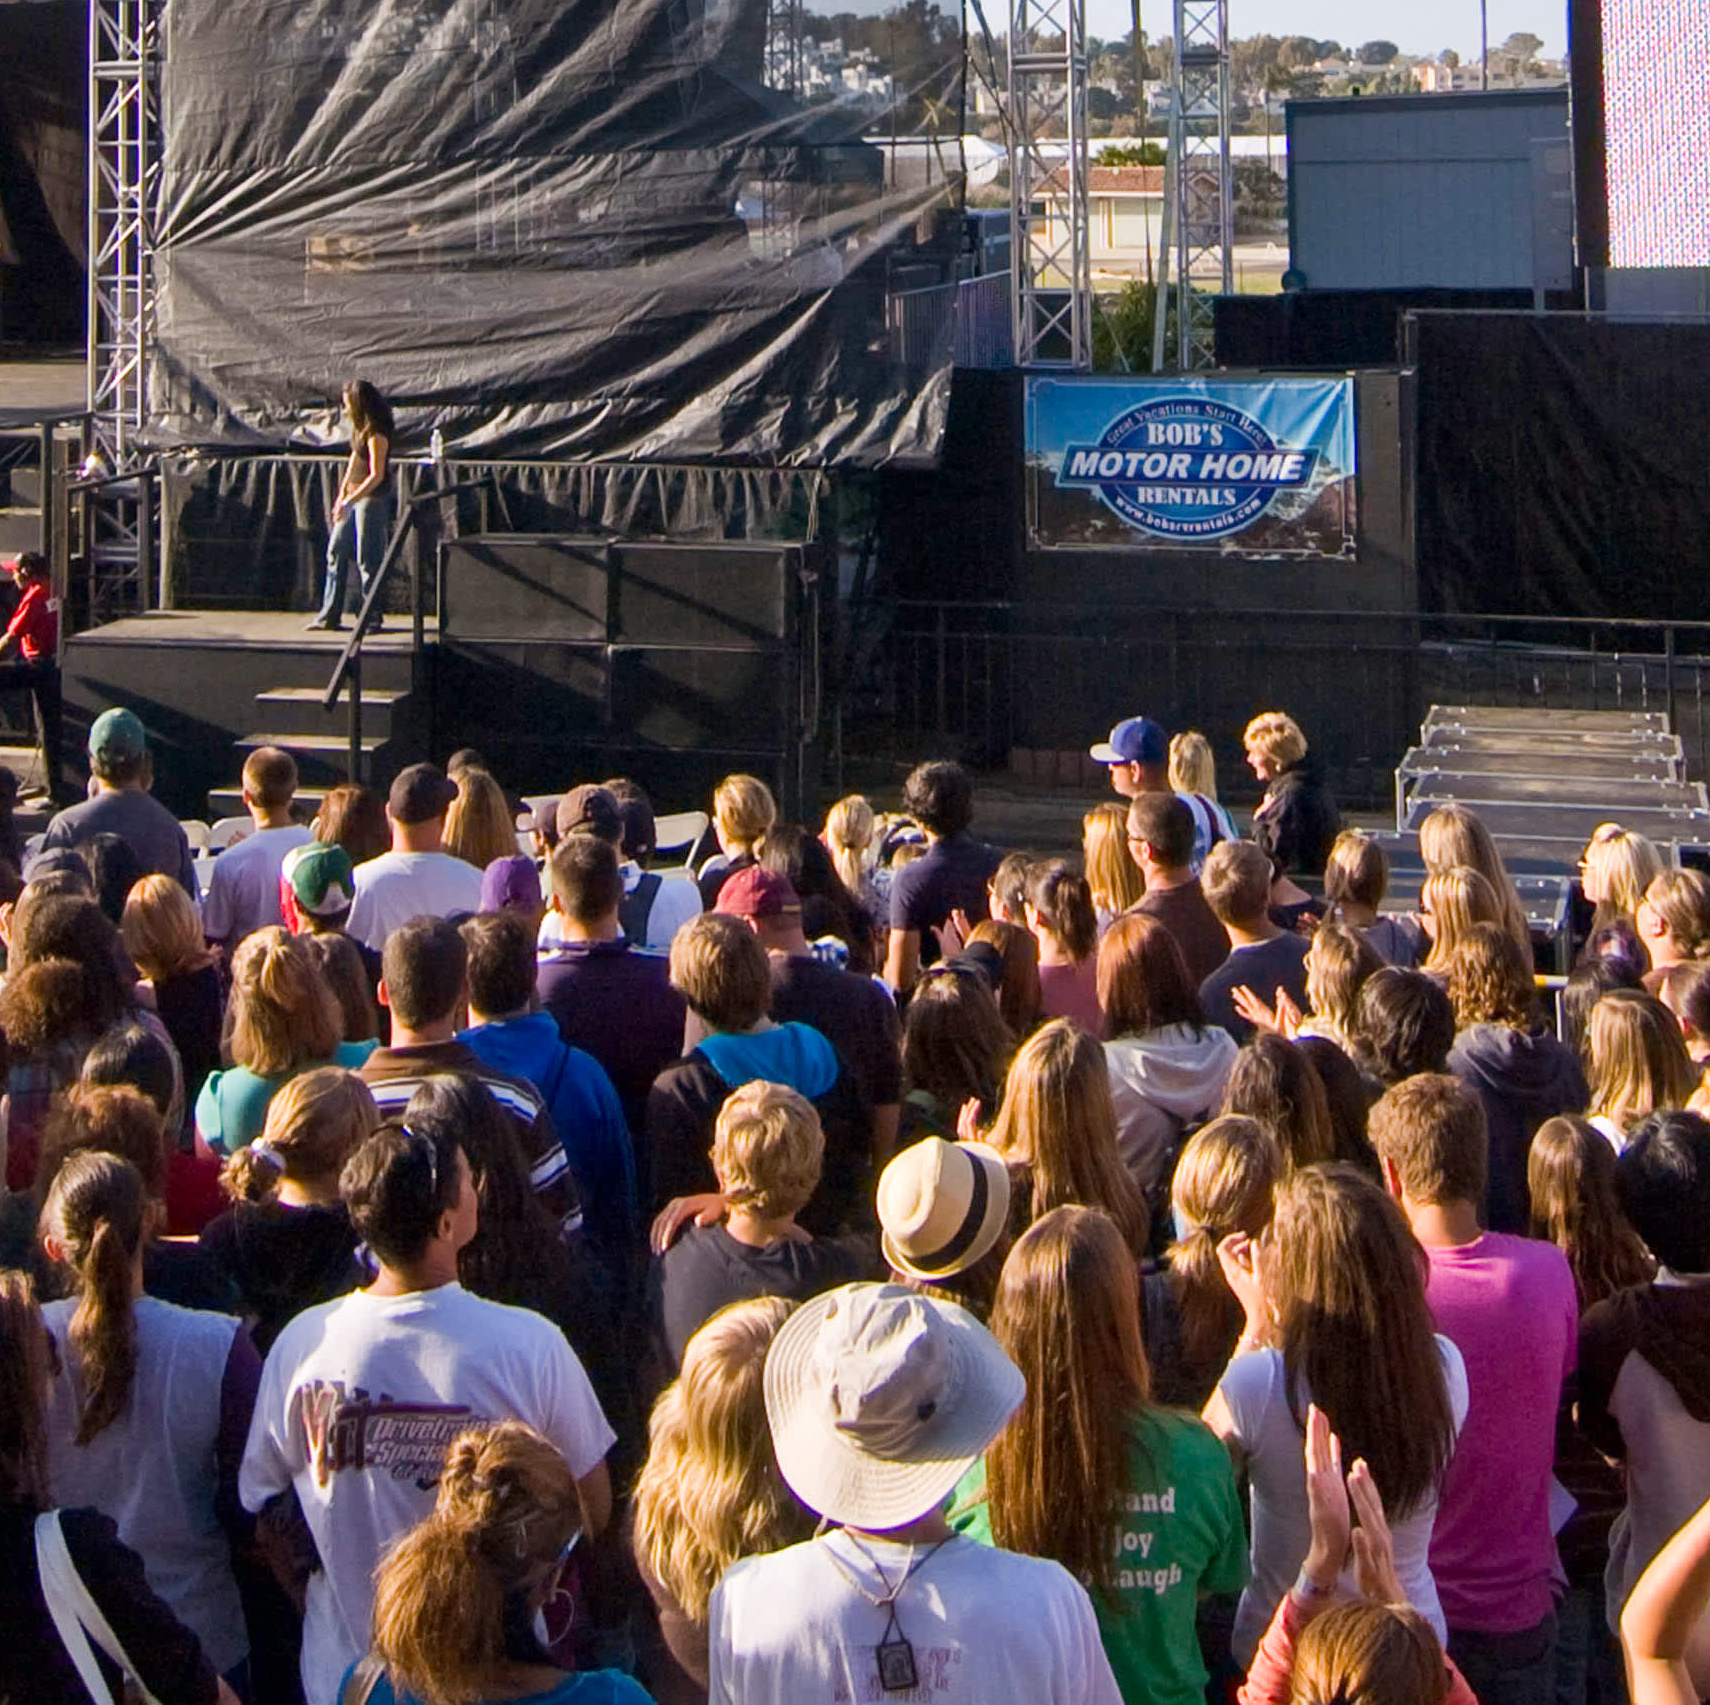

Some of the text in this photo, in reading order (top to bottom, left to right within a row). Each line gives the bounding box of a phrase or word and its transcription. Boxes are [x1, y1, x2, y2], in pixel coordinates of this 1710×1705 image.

[1134, 402, 1200, 423] Vacations
[1204, 403, 1237, 423] Start
[1146, 421, 1224, 446] BOB'S
[1068, 451, 1306, 482] MOTOR HOME
[1137, 485, 1237, 506] RENTALS
